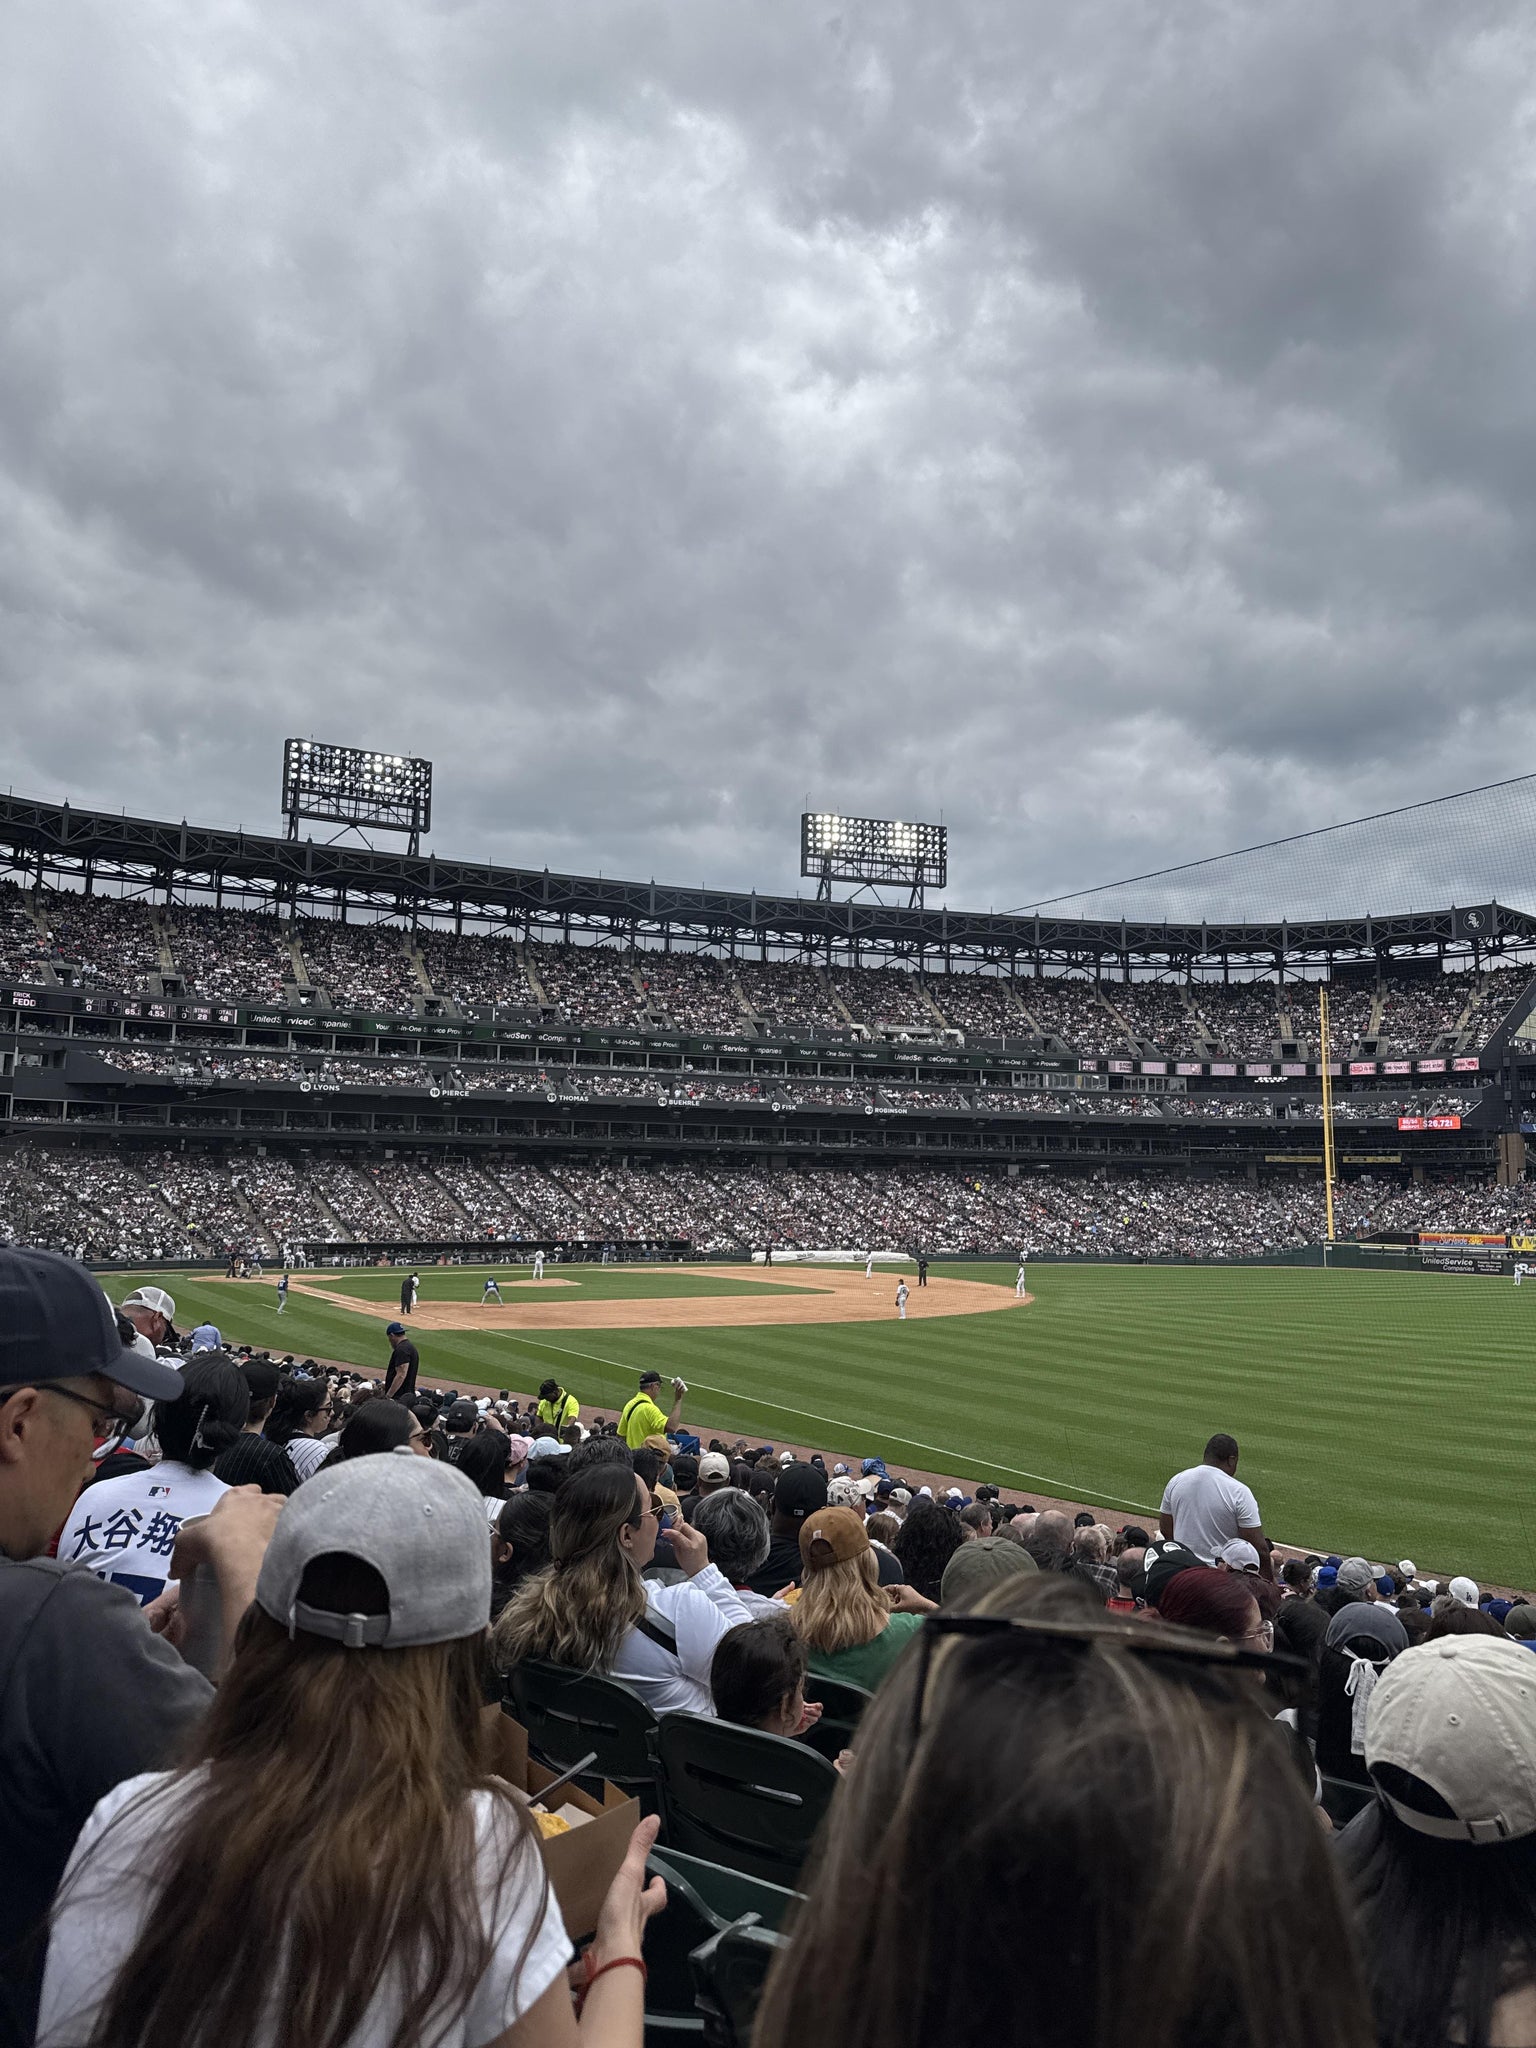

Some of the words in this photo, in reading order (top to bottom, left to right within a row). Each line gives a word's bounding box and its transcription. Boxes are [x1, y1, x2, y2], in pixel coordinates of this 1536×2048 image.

[147, 1010, 166, 1018] 4.52
[218, 1015, 229, 1023] 48
[313, 1084, 341, 1092] LYONS
[442, 1089, 470, 1098] PIERCE
[558, 1094, 589, 1102] THOMAS
[668, 1099, 701, 1107] BUEHRLE
[874, 1107, 908, 1115] ROBINSON
[1422, 1257, 1474, 1267] UnitedService
[1442, 1264, 1475, 1274] Companies
[96, 1570, 166, 1609] 7
